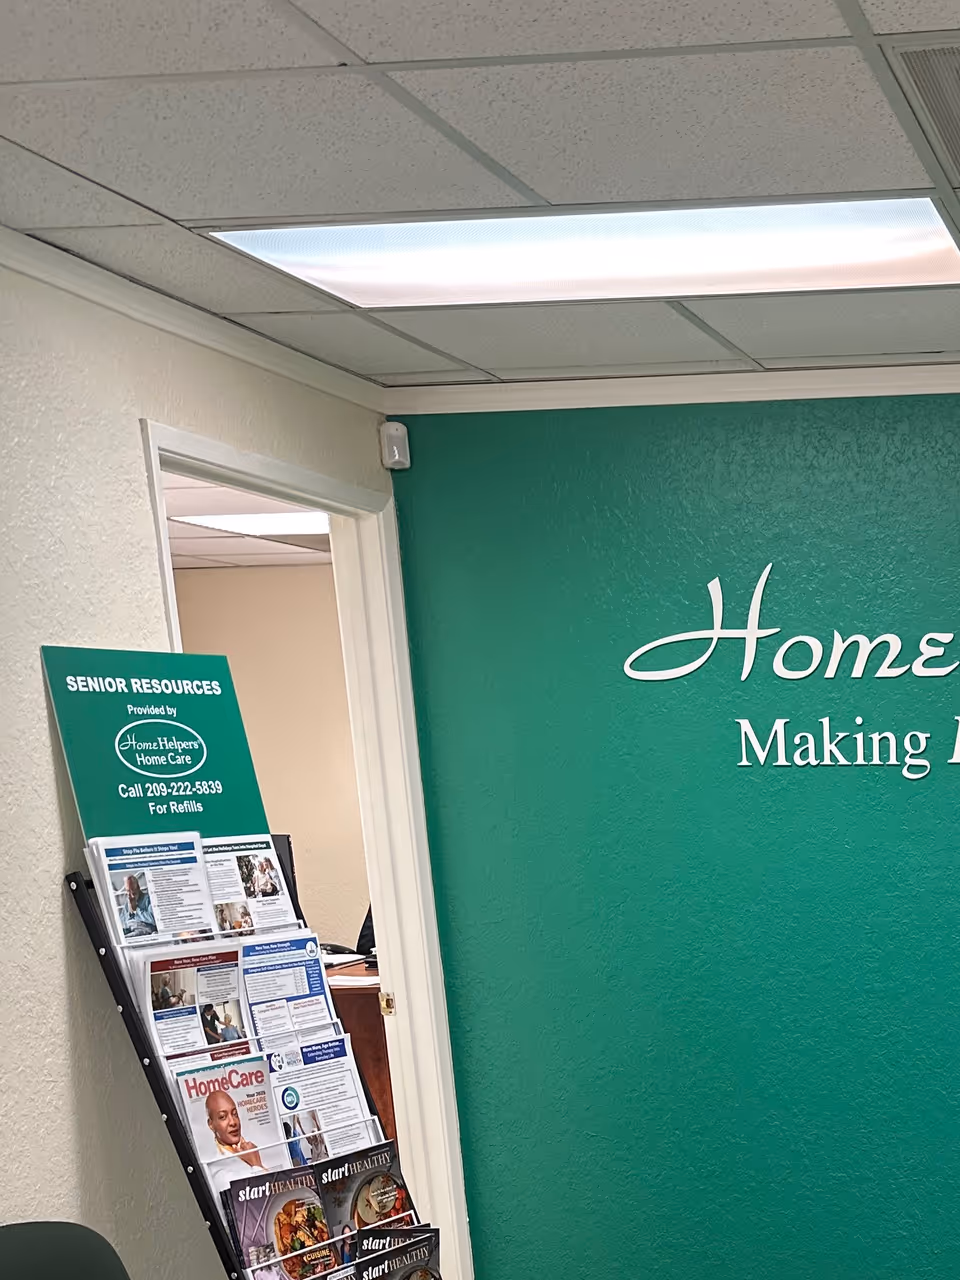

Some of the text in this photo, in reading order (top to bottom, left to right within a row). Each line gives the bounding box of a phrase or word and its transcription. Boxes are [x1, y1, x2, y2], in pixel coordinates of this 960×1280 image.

[624, 562, 960, 681] Home
[66, 676, 222, 695] SENIOR RESOURCES
[127, 704, 177, 717] Provided by
[119, 733, 158, 750] Home
[735, 716, 931, 780] Making
[136, 753, 192, 766] Home Care
[118, 780, 223, 798] Call 209-222-5839
[149, 801, 204, 814] For Refills
[184, 1069, 264, 1098] HomeCare
[247, 1103, 268, 1113] HEROES
[306, 1248, 330, 1260] CUISINE
